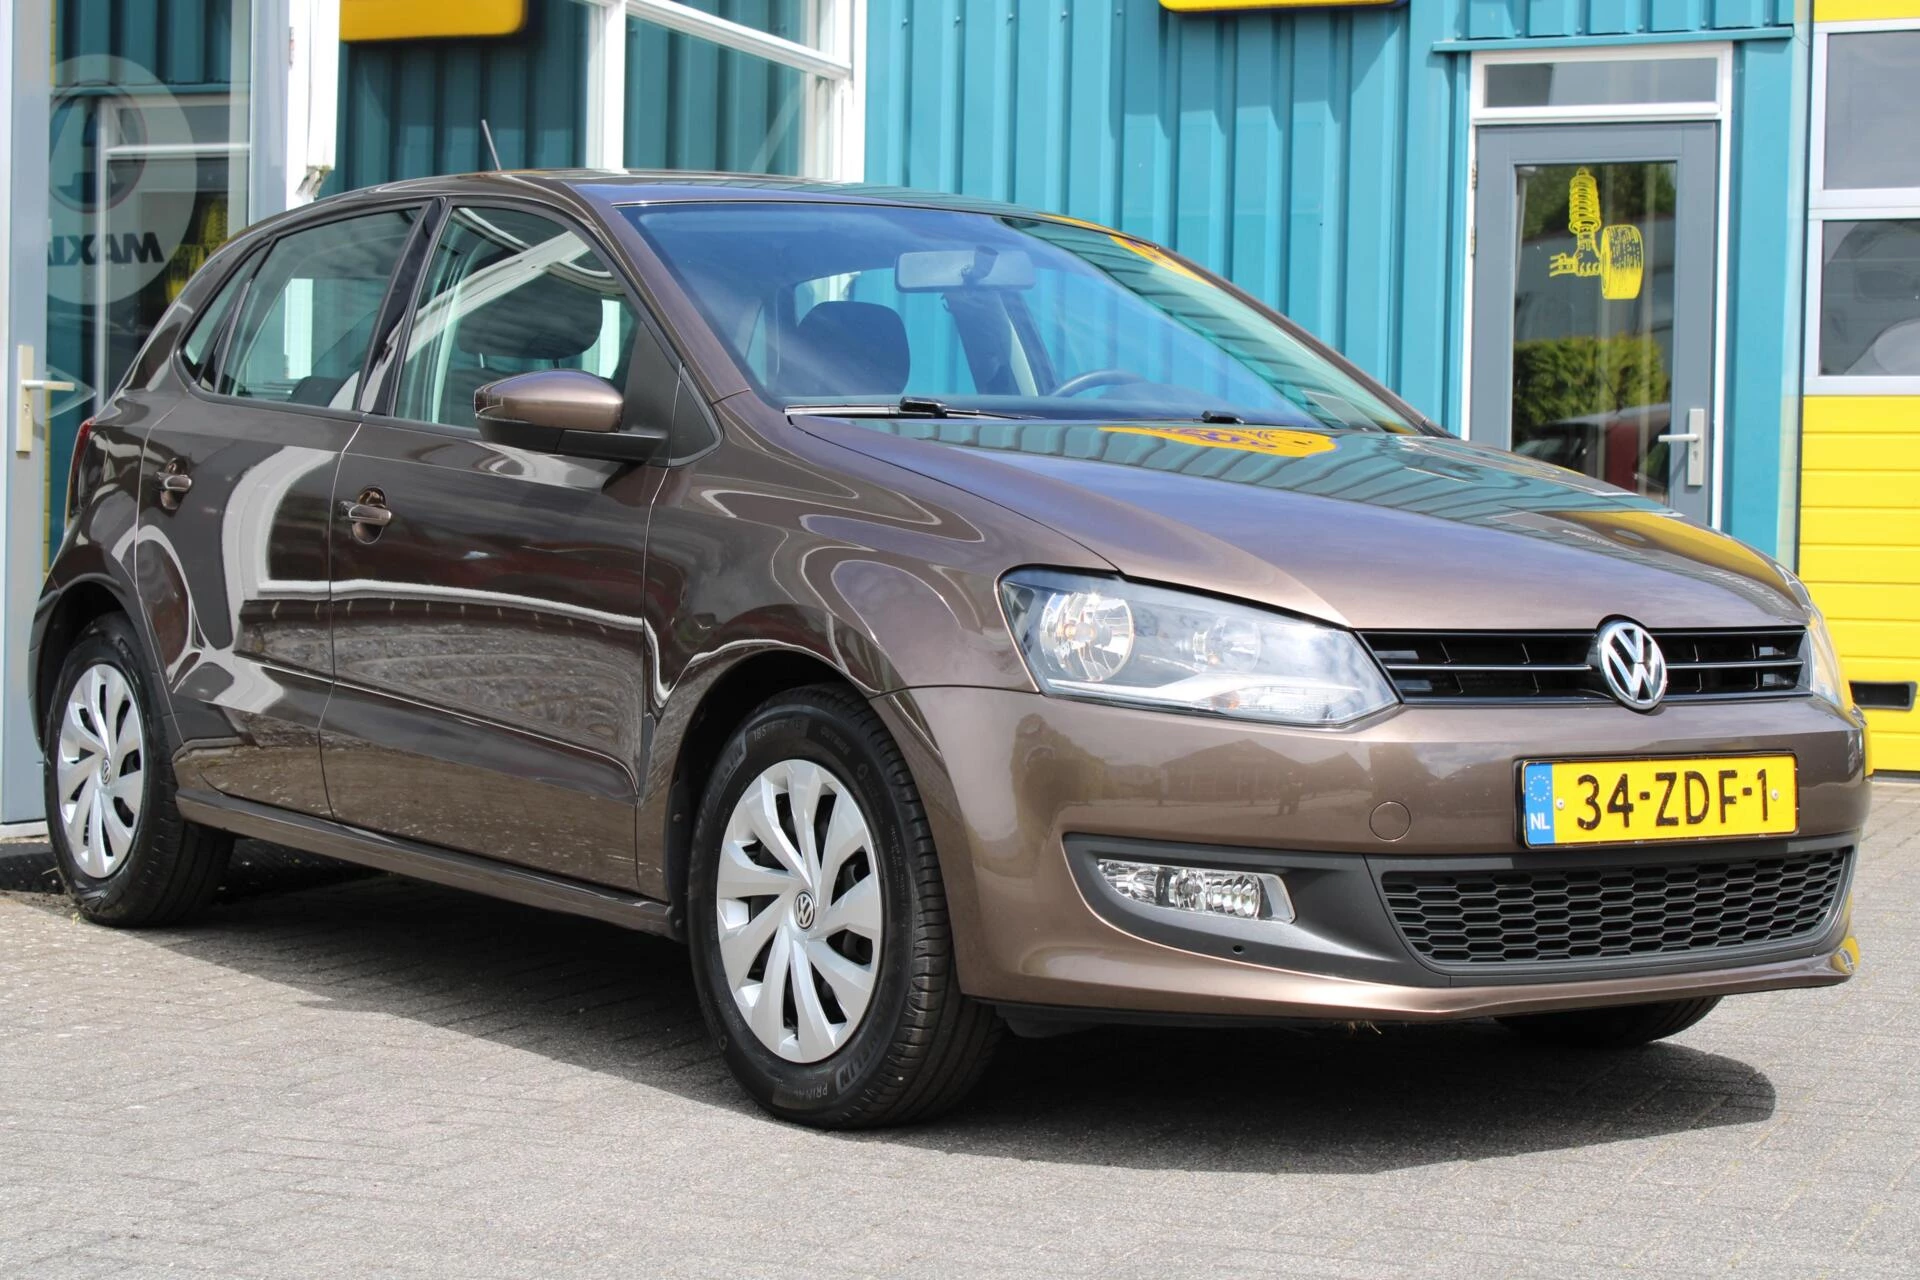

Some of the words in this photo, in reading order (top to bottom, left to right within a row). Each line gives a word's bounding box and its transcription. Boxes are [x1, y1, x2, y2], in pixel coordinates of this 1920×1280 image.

[47, 232, 165, 266] IXAM
[1576, 769, 1768, 831] 34-ZDF-1
[1530, 812, 1550, 830] NL
